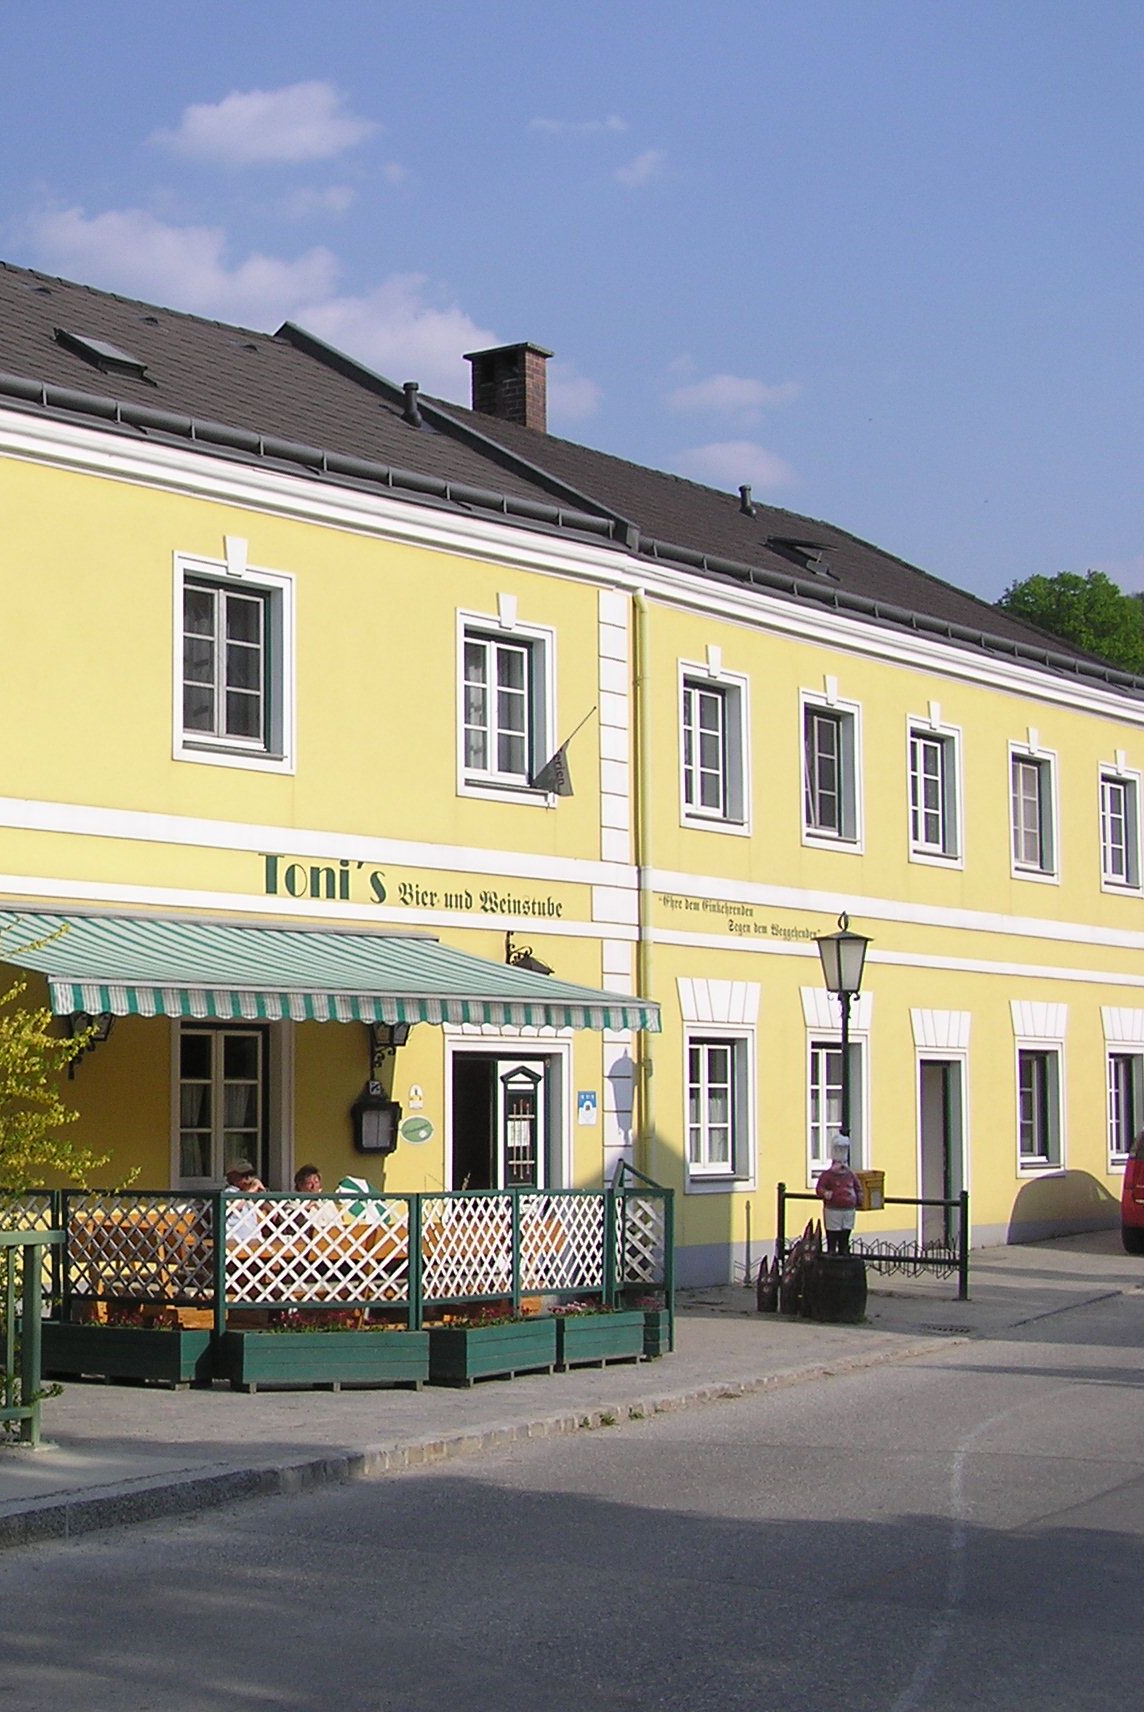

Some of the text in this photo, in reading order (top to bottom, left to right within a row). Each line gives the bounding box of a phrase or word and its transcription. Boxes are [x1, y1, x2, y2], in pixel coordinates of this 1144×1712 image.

[258, 852, 386, 904] Toni's
[444, 889, 473, 910] und
[479, 891, 562, 918] Weinstube
[685, 898, 700, 911] dem
[728, 919, 751, 936] Segen
[754, 922, 768, 934] dem
